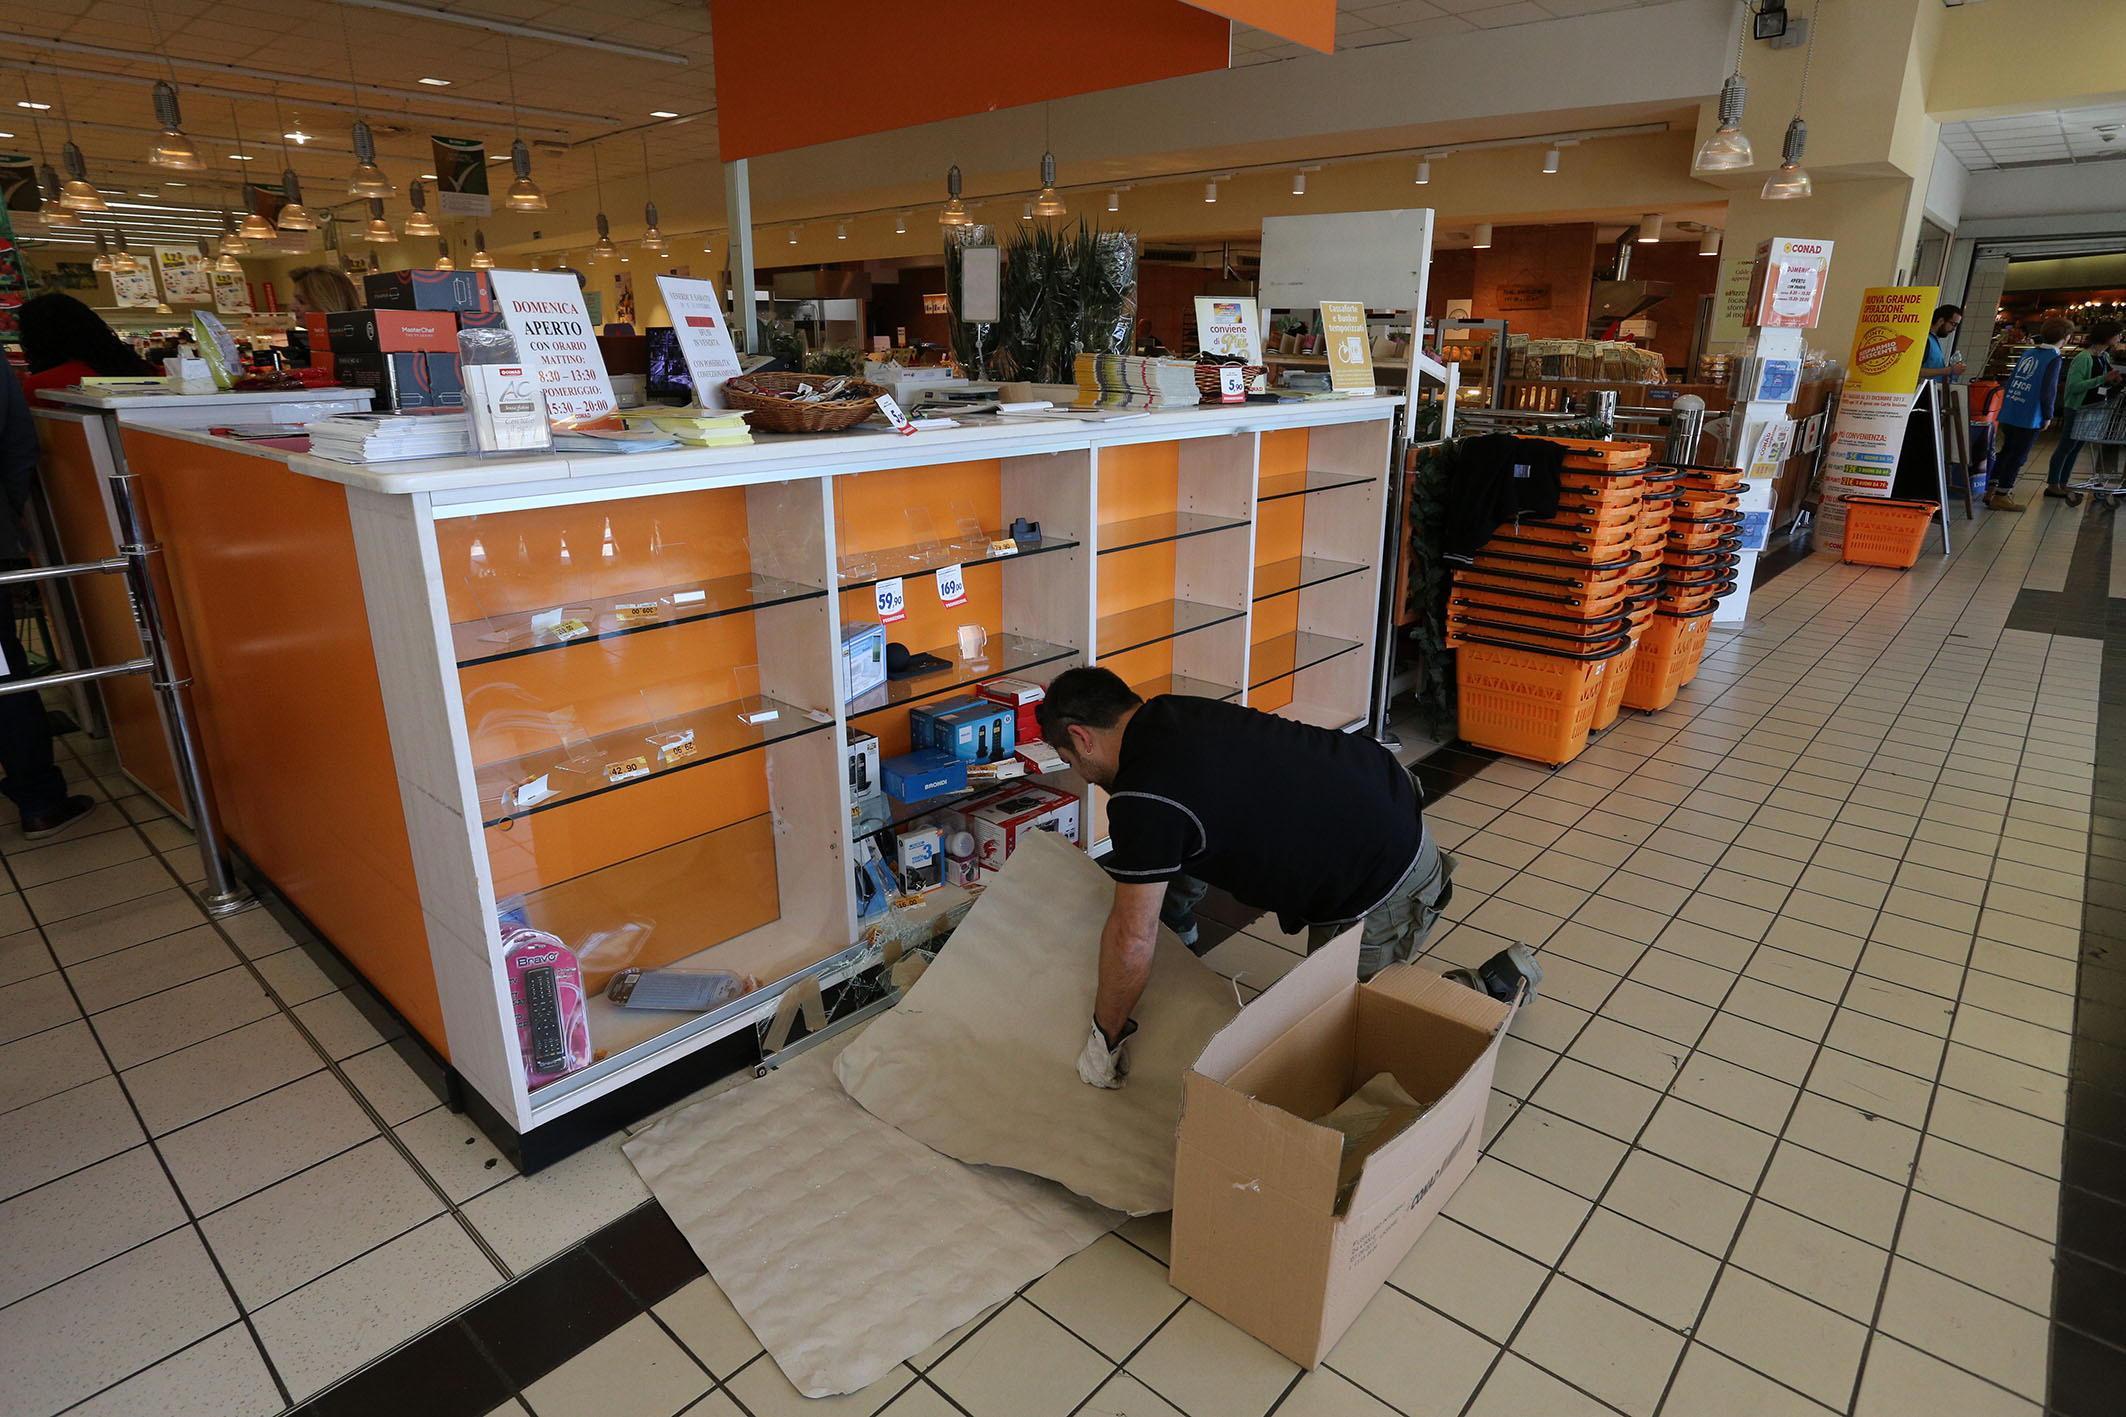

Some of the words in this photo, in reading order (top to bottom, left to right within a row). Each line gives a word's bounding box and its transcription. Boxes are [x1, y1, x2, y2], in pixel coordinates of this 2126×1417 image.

[1791, 244, 1822, 254] CONAD
[1886, 295, 1921, 304] GRANDE
[512, 300, 579, 315] DOMENICA
[1892, 314, 1920, 323] PUNTI.
[525, 321, 582, 336] APERTO
[1210, 324, 1247, 334] conviene
[530, 341, 550, 351] CON
[552, 341, 587, 351] ORARIO
[1213, 337, 1221, 345] di
[540, 355, 586, 365] MATTINO:
[538, 370, 561, 382] 8:30
[571, 369, 597, 381] 13:30
[542, 386, 602, 397] POMERIGGIO:
[1228, 380, 1243, 392] 5,90
[583, 399, 609, 412] 20:00
[878, 592, 902, 610] 59,90
[924, 779, 948, 791] BRONDI
[517, 953, 559, 967] Bravo
